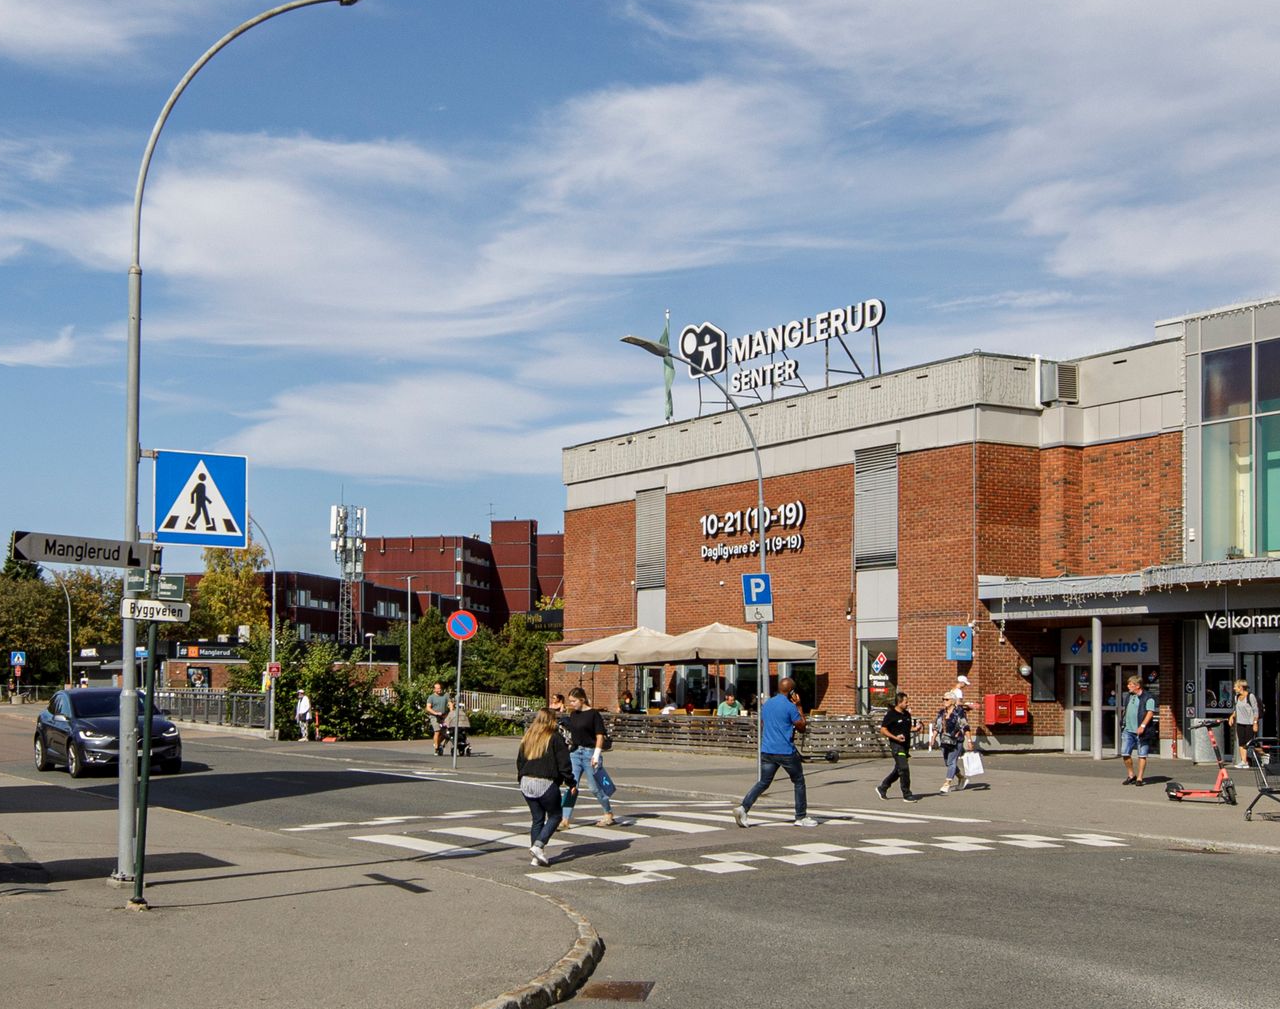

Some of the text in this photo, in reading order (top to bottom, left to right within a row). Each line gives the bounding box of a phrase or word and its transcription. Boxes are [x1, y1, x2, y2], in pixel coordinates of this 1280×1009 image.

[731, 298, 884, 364] MANGLERUD
[731, 359, 799, 393] SENTER
[700, 511, 741, 535] 10-21
[44, 539, 120, 561] Manglerud
[701, 543, 748, 560] Dagligvare
[750, 578, 765, 602] P
[130, 602, 183, 618] Byggveien
[199, 648, 231, 657] Manglerud
